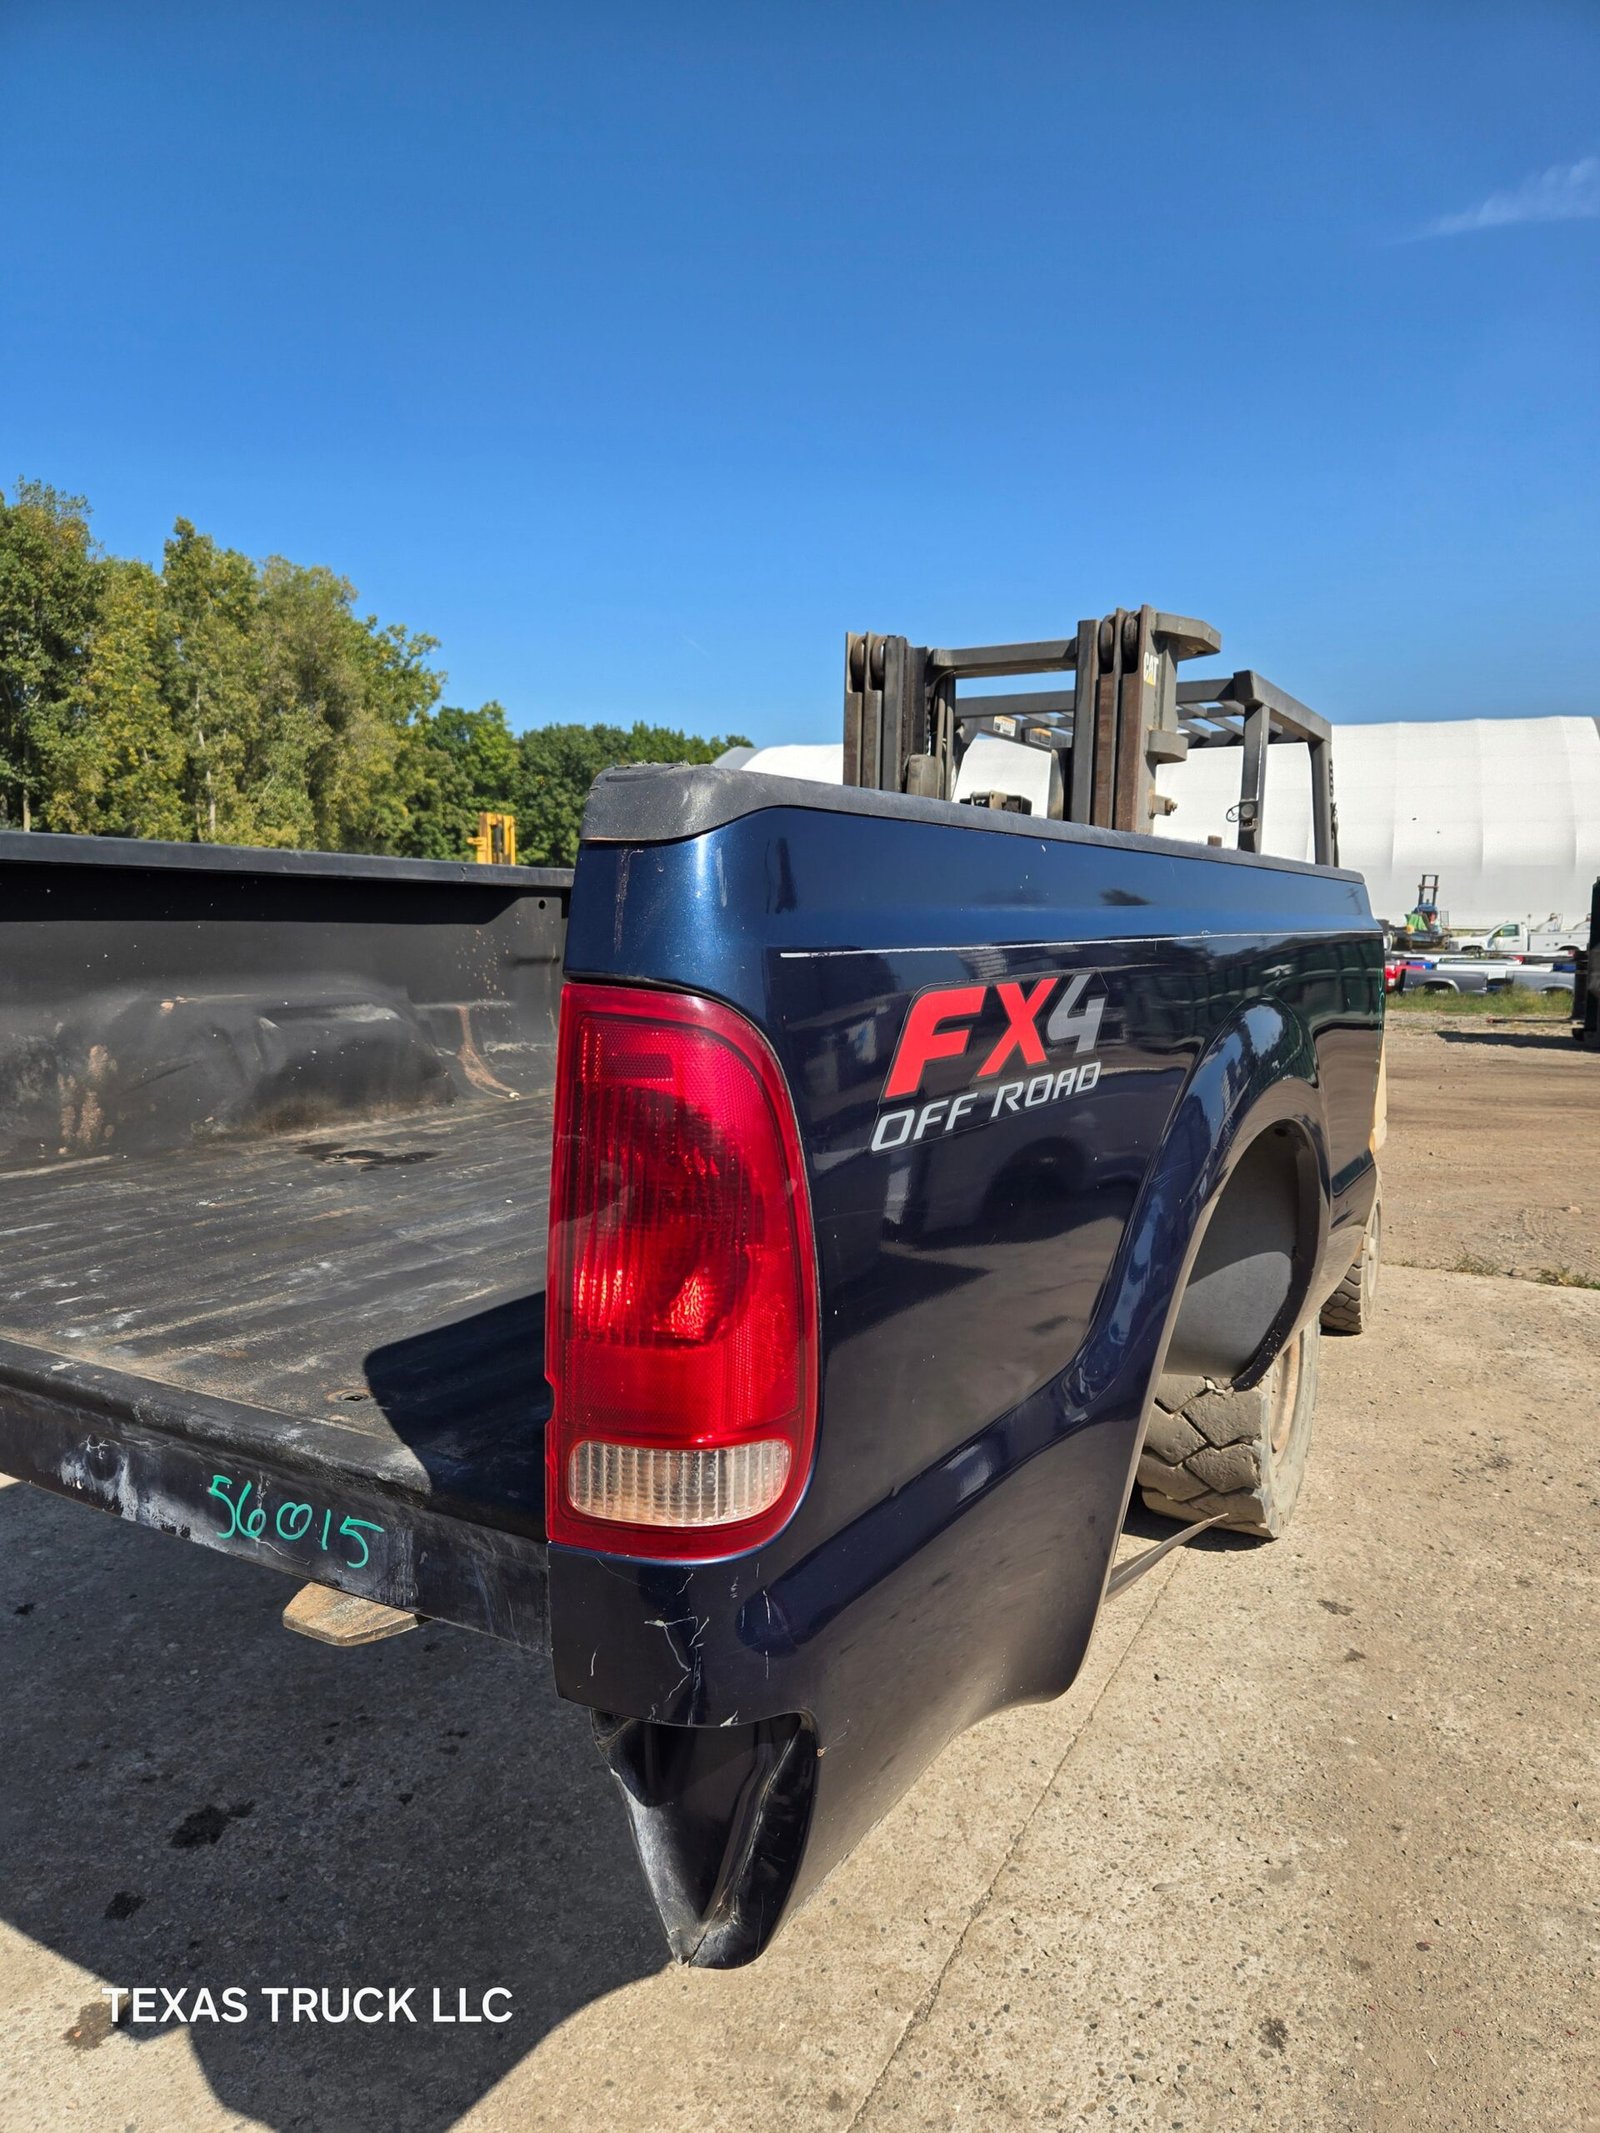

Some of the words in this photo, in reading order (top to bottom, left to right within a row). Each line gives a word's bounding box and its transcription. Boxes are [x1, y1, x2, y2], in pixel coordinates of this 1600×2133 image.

[1143, 651, 1159, 687] CAT
[884, 973, 1106, 1098] FX4
[871, 1092, 978, 1151] OFF
[991, 1061, 1101, 1118] ROAD
[207, 1474, 385, 1568] 56015
